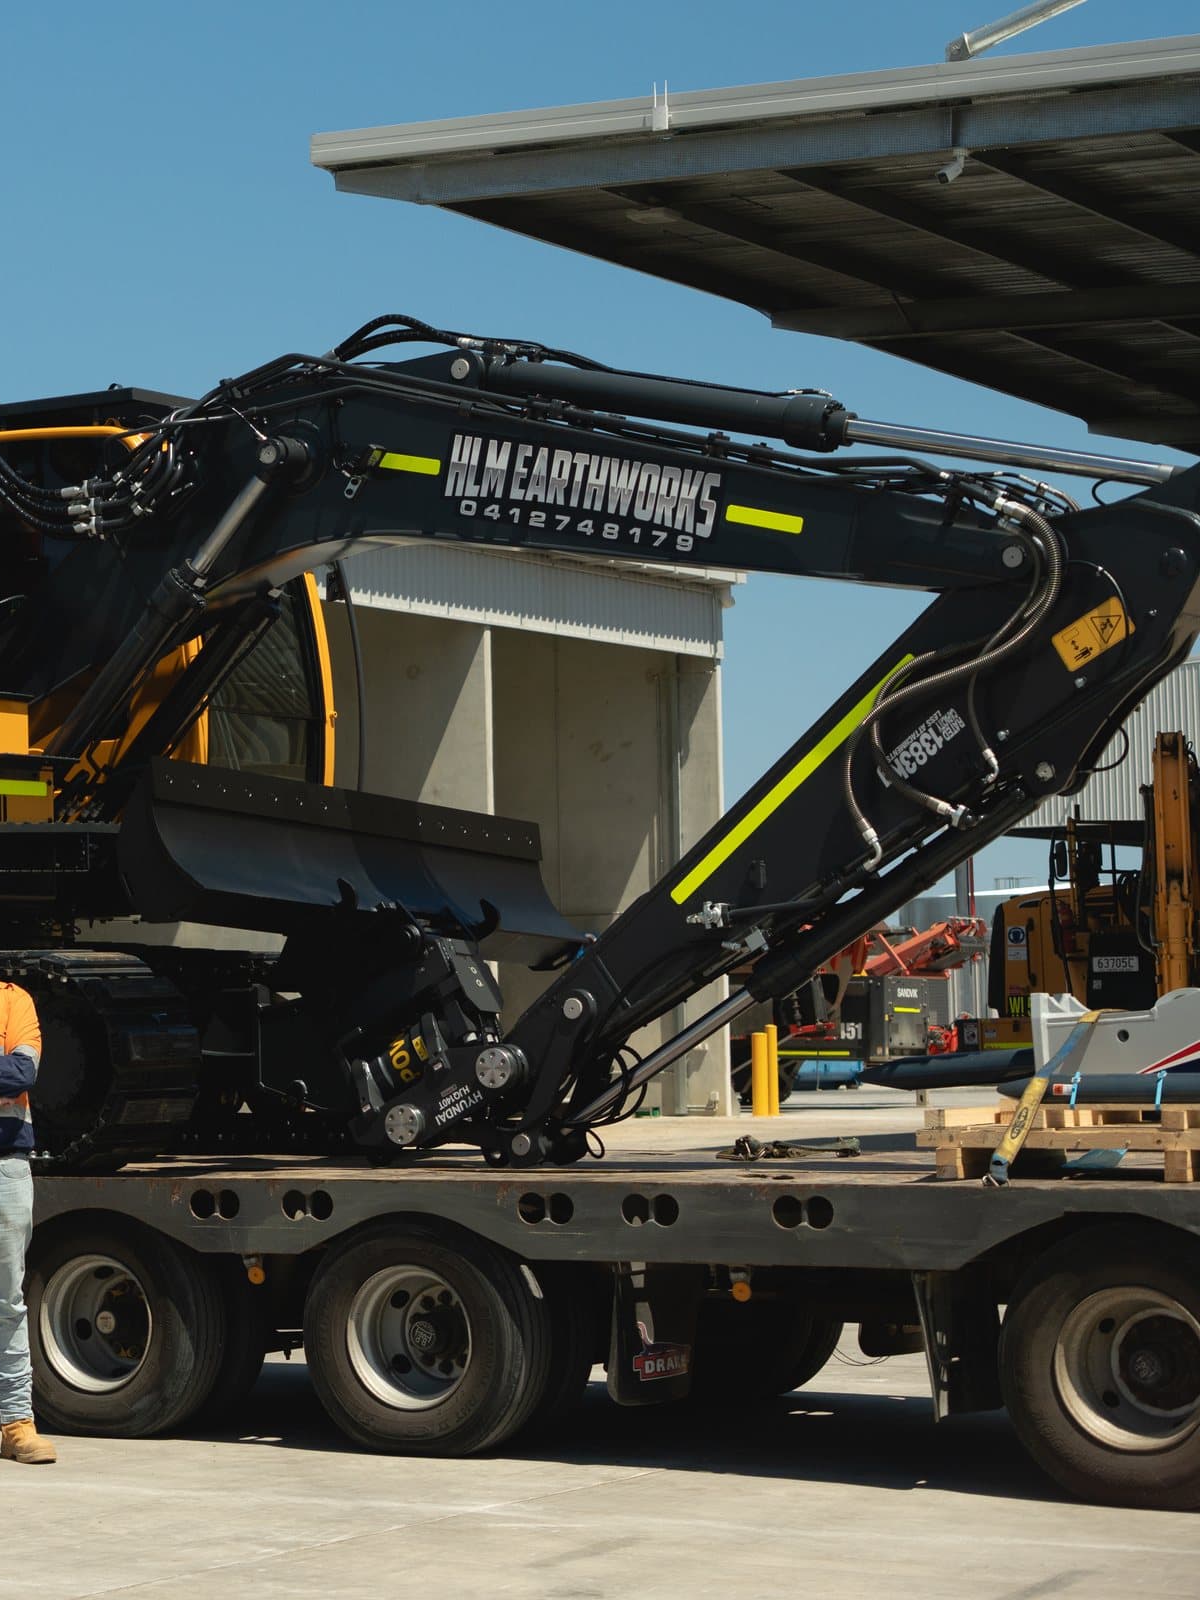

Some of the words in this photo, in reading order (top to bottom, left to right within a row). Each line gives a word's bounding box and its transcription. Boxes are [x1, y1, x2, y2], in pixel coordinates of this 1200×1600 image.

[444, 434, 511, 498] HLM
[509, 443, 721, 539] EARTHWORKS
[459, 499, 694, 552] 0412748179
[434, 1089, 483, 1126] HYUNDAI
